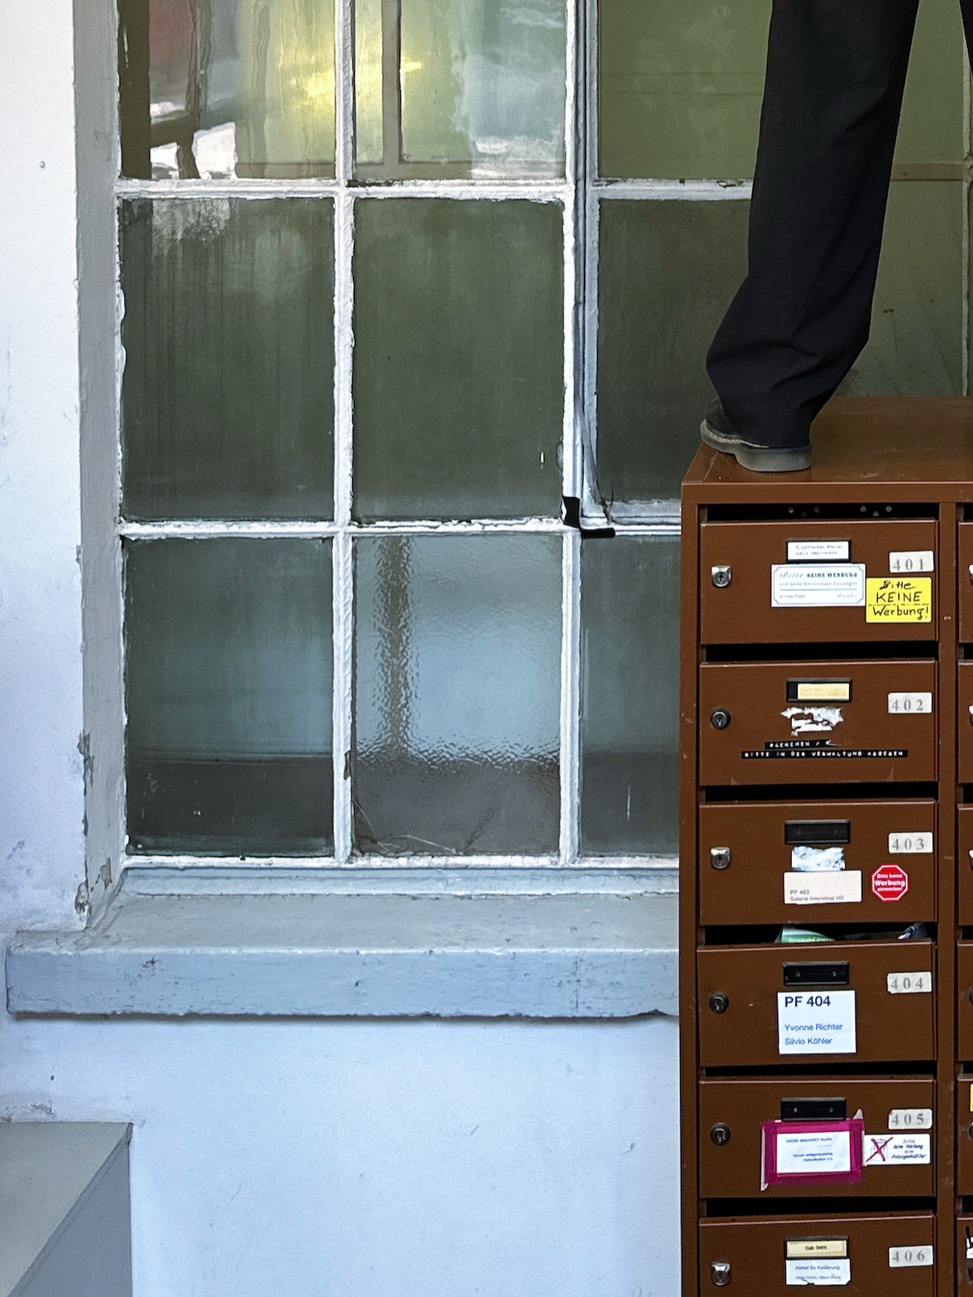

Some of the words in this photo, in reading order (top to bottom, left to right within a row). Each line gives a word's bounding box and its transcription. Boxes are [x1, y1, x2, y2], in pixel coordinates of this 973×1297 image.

[892, 558, 925, 571] 401
[879, 580, 917, 590] Bitte
[876, 591, 922, 603] KEINE
[873, 605, 929, 621] Werbung!
[891, 699, 924, 711] 402
[891, 838, 925, 850] 403
[874, 879, 906, 887] Werbung
[891, 977, 924, 990] 404
[784, 996, 803, 1007] PF
[806, 995, 831, 1007] 404
[784, 1024, 814, 1032] Yvonne
[815, 1023, 843, 1031] Richter
[784, 1037, 806, 1045] Silvio
[807, 1037, 833, 1045] Köhler
[891, 1113, 925, 1126] 405
[892, 1250, 925, 1263] 406
